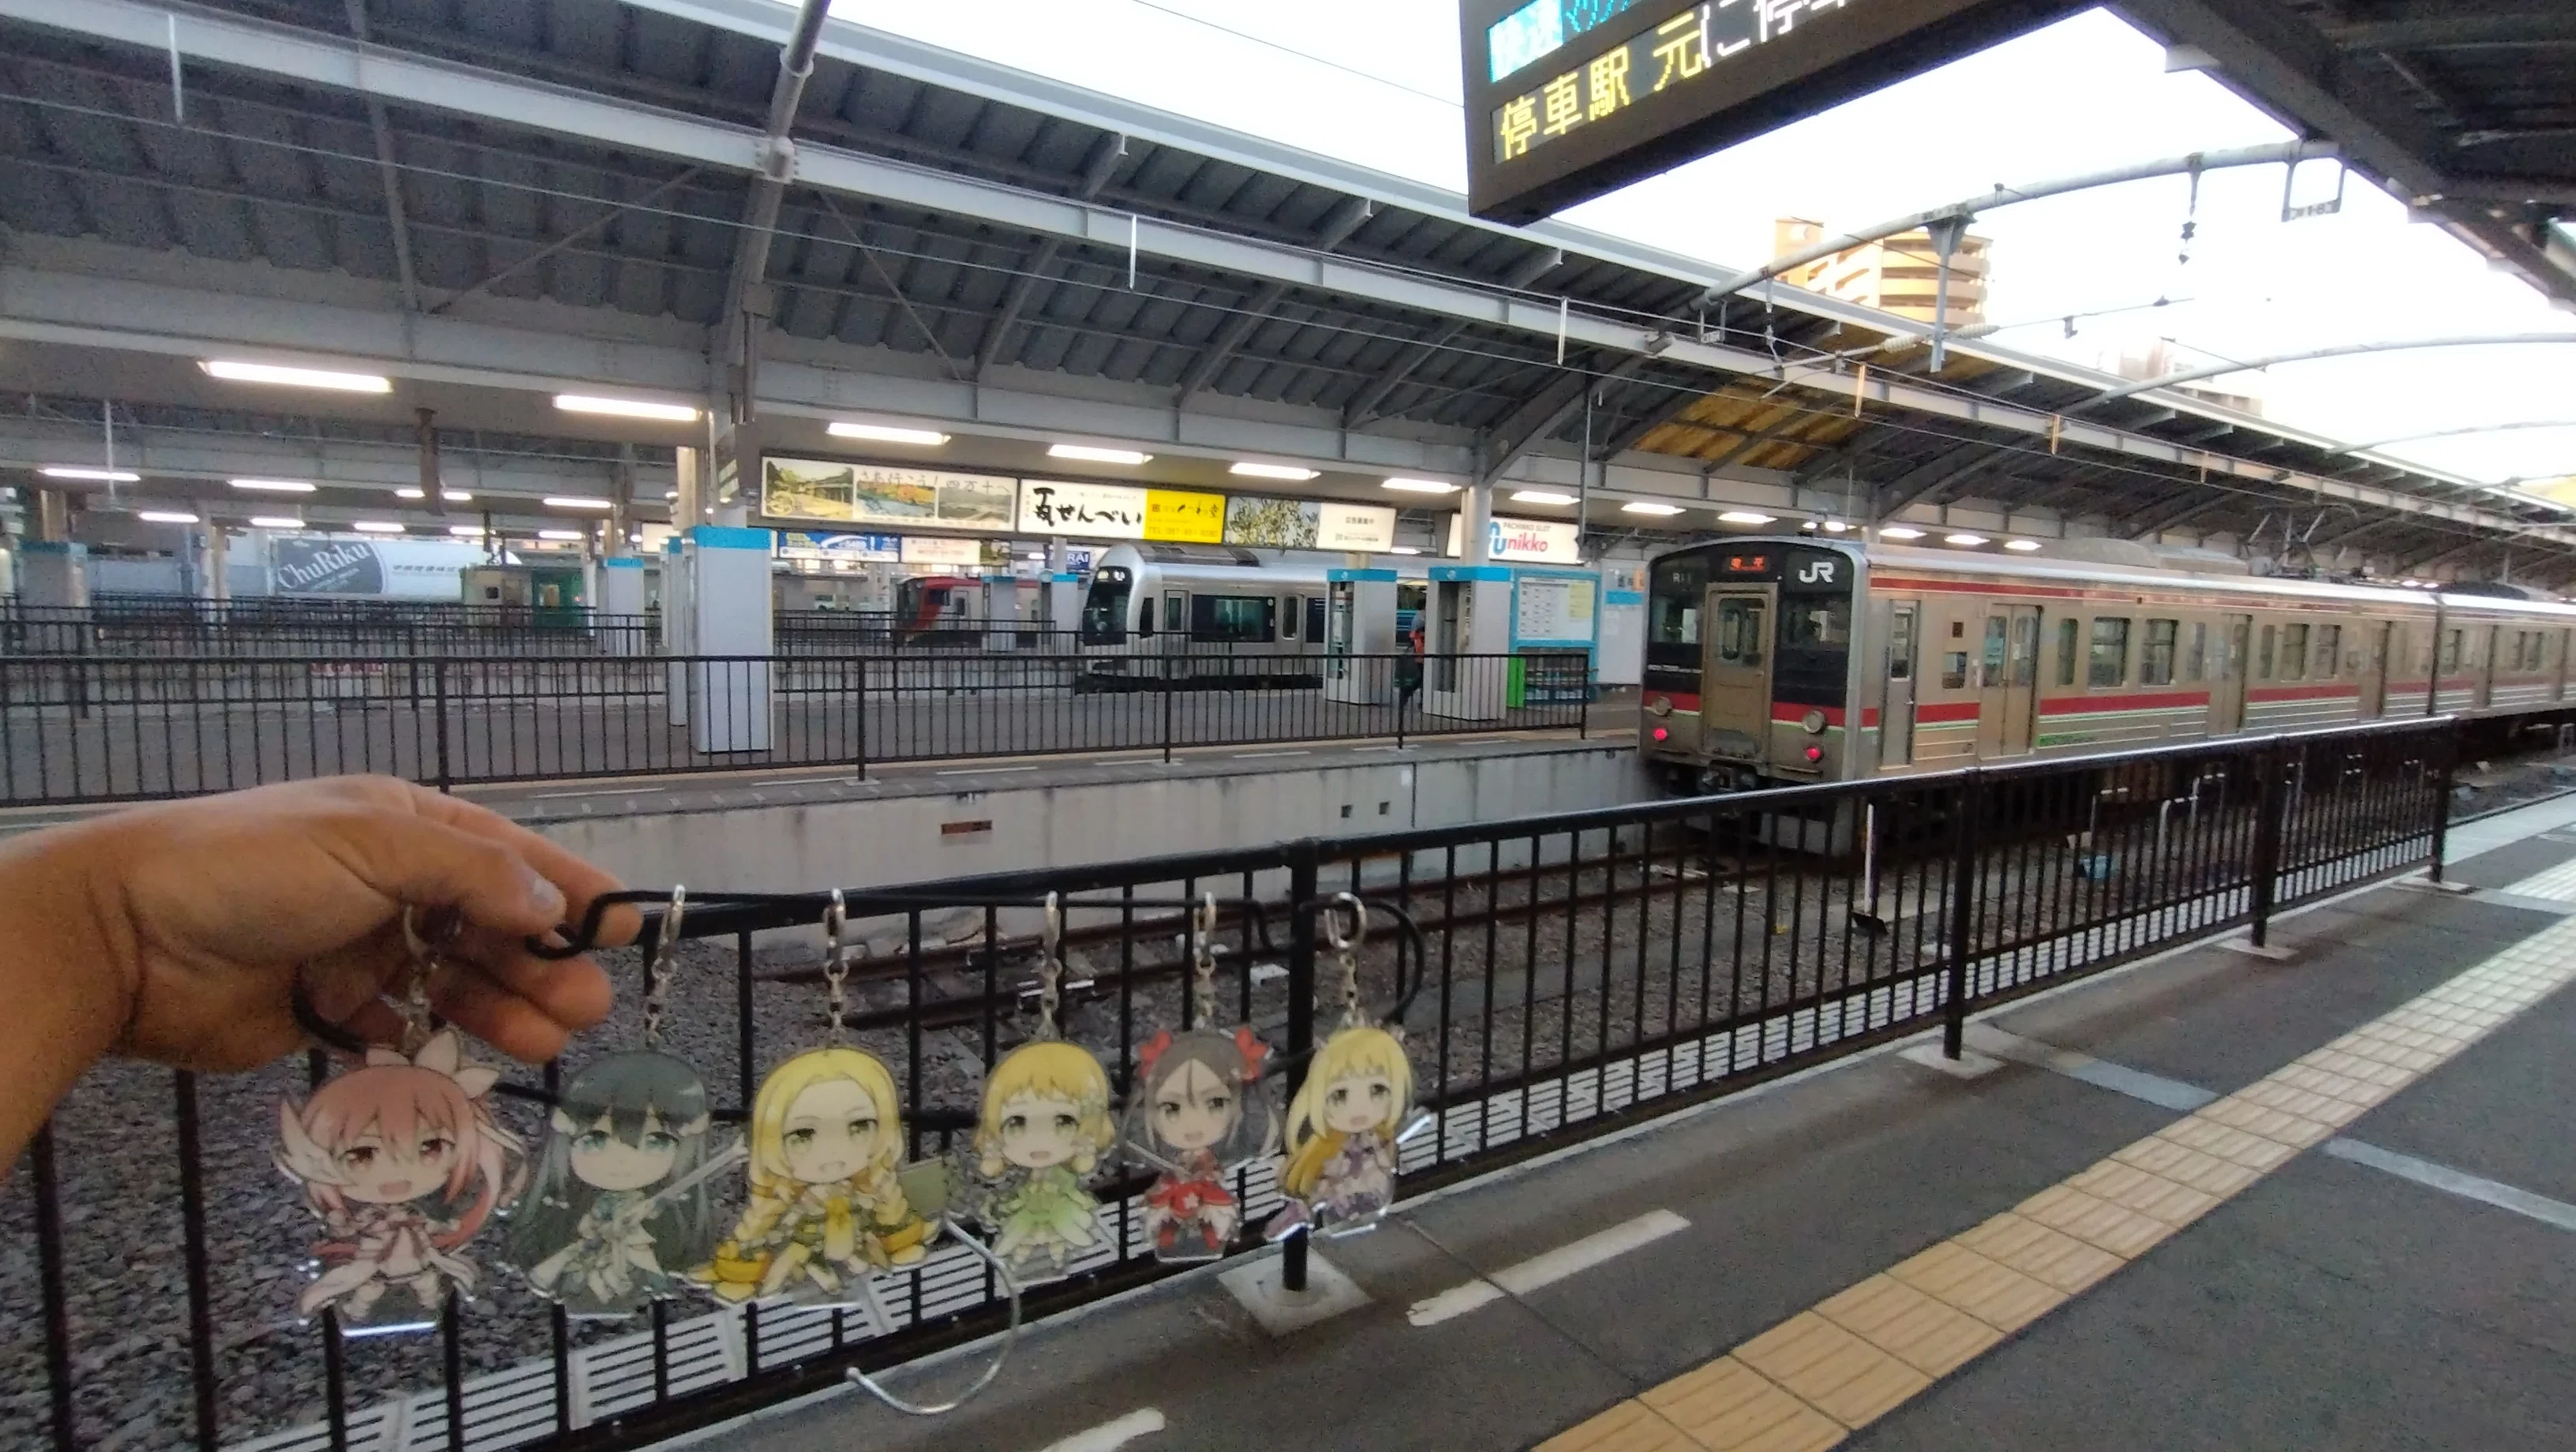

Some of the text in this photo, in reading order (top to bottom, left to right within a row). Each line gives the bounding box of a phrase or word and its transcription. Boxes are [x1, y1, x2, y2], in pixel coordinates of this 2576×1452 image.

[1500, 45, 1631, 159] 停車駅
[1033, 487, 1142, 527] 瓦せんべい
[1503, 522, 1534, 530] PACHINKO
[278, 541, 373, 589] ChuRiku
[1799, 562, 1834, 583] JR
